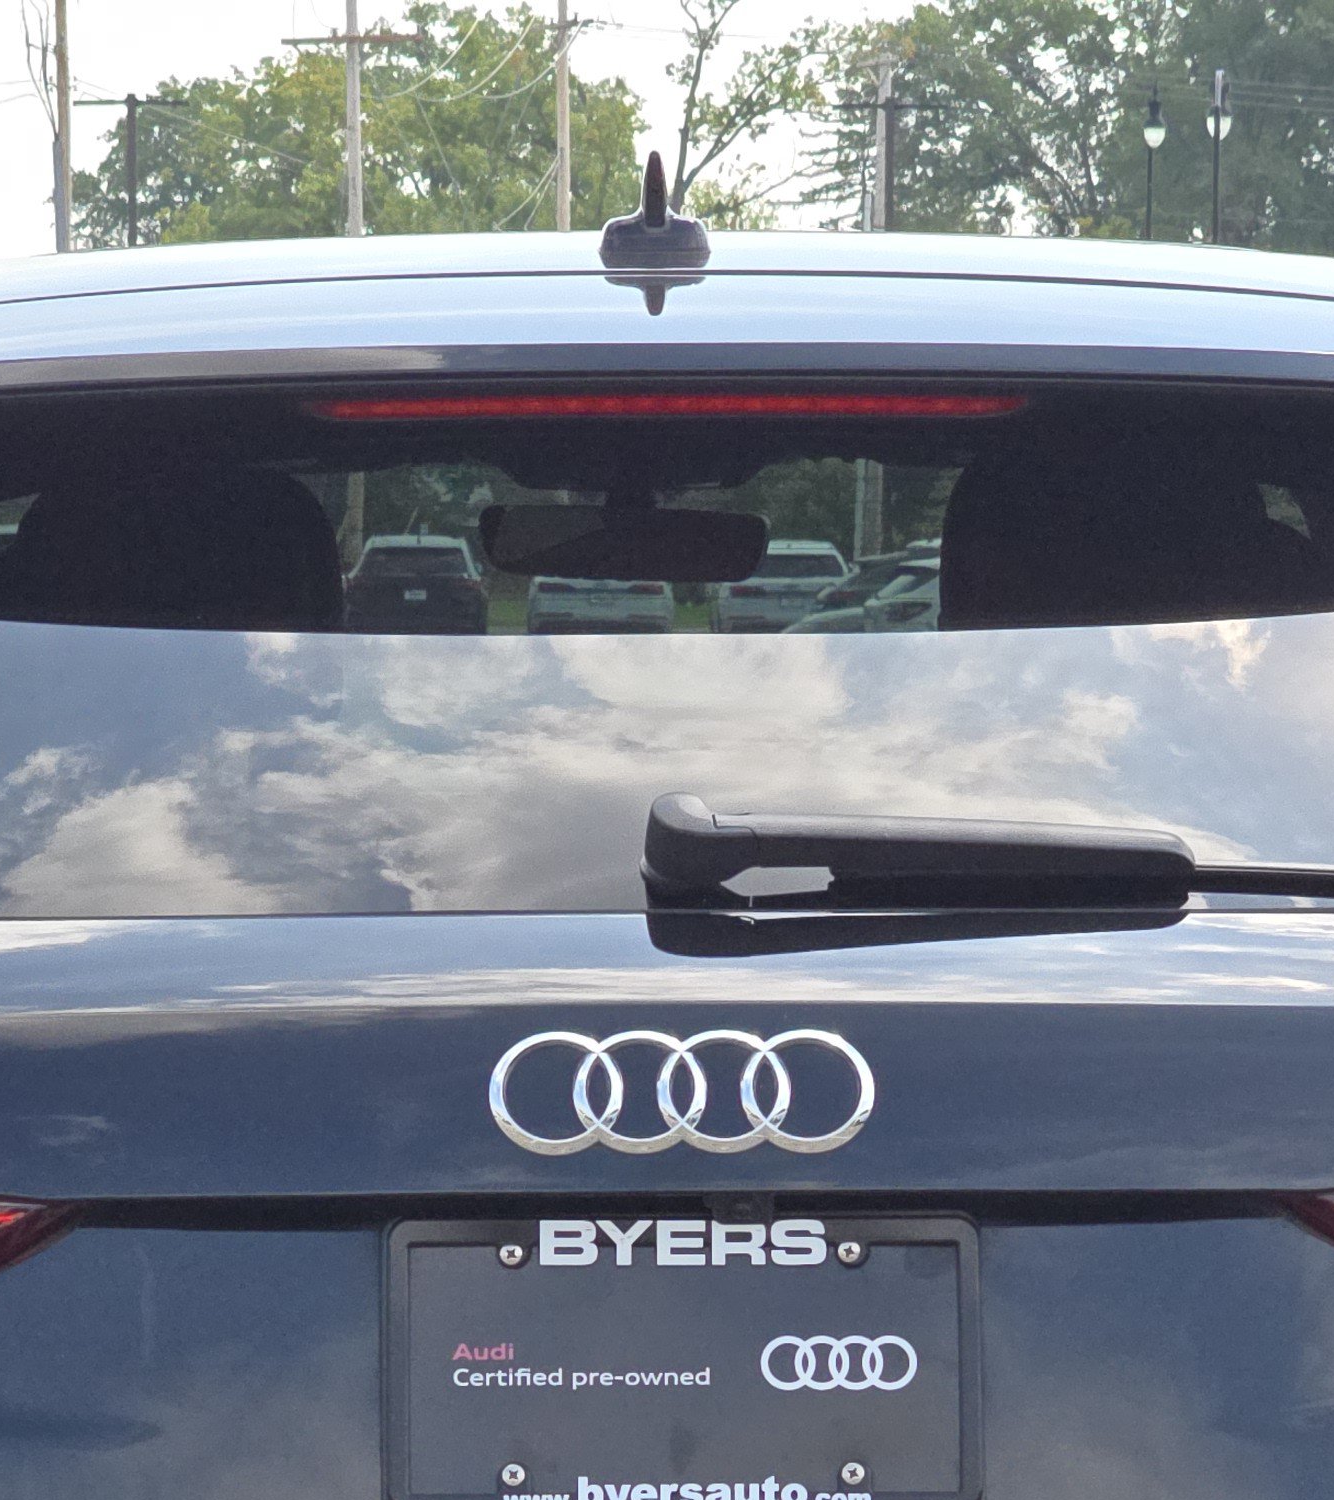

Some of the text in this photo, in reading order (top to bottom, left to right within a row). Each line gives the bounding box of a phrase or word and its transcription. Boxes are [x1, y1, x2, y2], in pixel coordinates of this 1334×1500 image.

[539, 1218, 828, 1267] BYERS
[452, 1342, 515, 1361] Audi
[452, 1366, 711, 1390] Certified pre-owned
